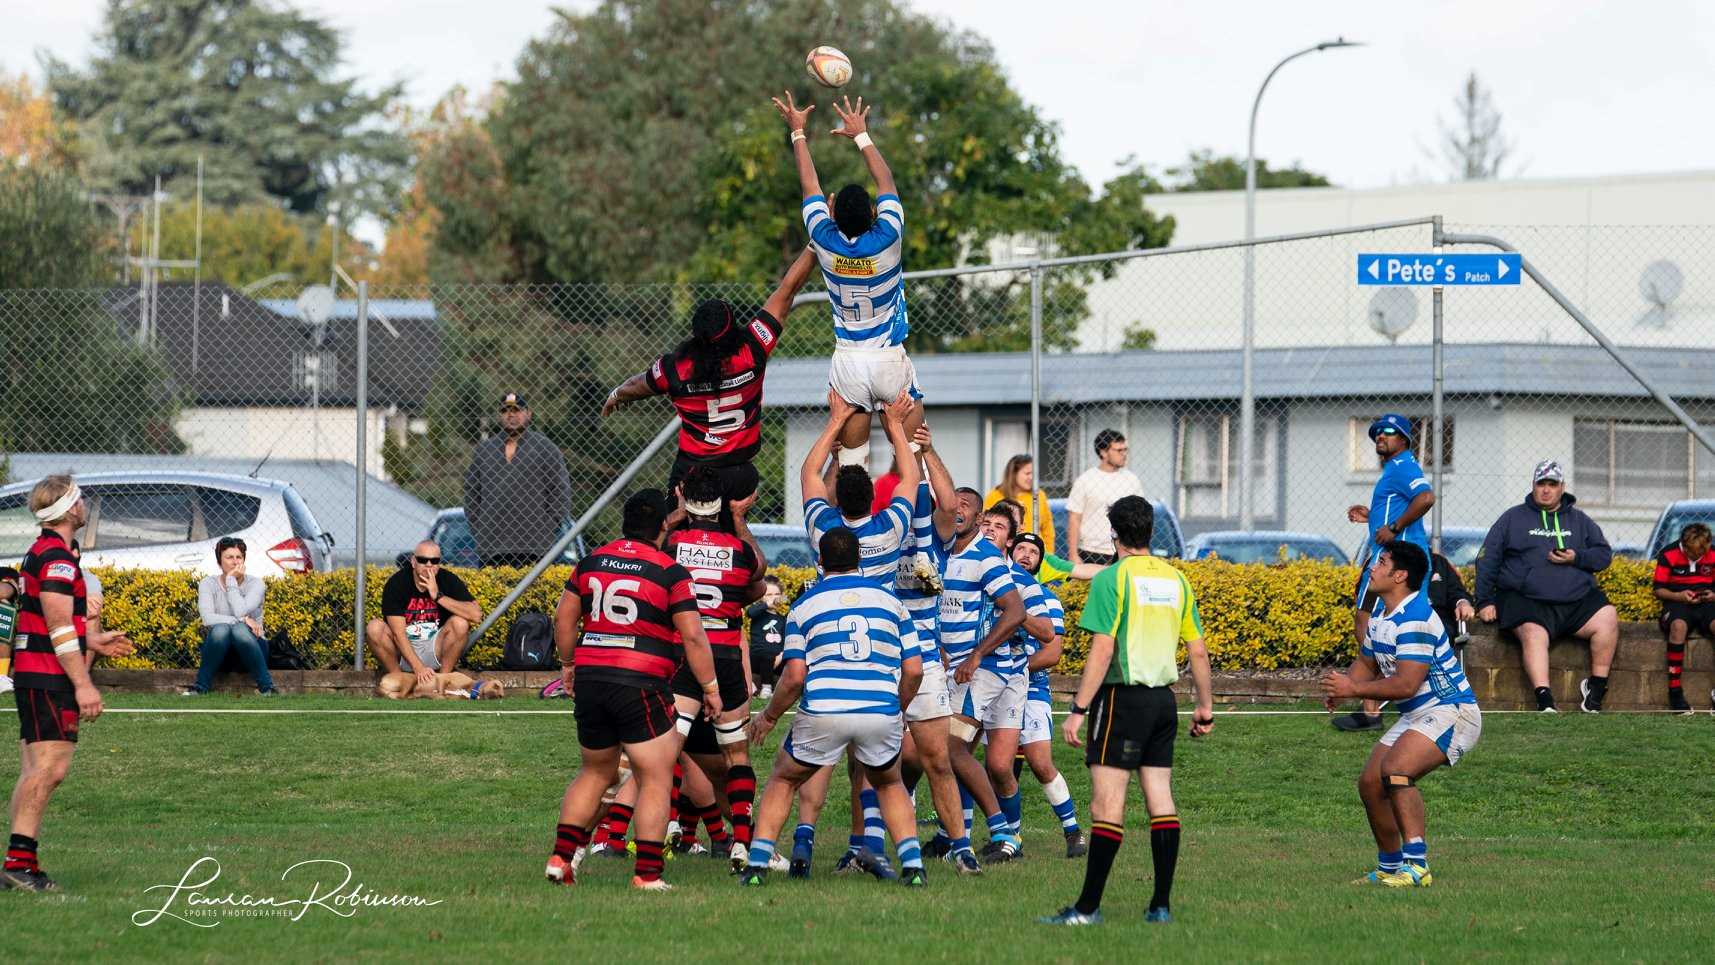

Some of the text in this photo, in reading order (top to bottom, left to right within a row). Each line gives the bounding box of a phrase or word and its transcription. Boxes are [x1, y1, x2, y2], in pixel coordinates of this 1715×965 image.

[836, 257, 872, 267] WAIKATO
[1465, 271, 1491, 283] Patch
[839, 284, 875, 322] 5
[706, 393, 746, 434] 5
[679, 546, 731, 560] HALO
[608, 559, 643, 572] KUKRI
[679, 556, 731, 569] SYSTEMS
[588, 575, 640, 626] 16
[837, 614, 872, 662] 3
